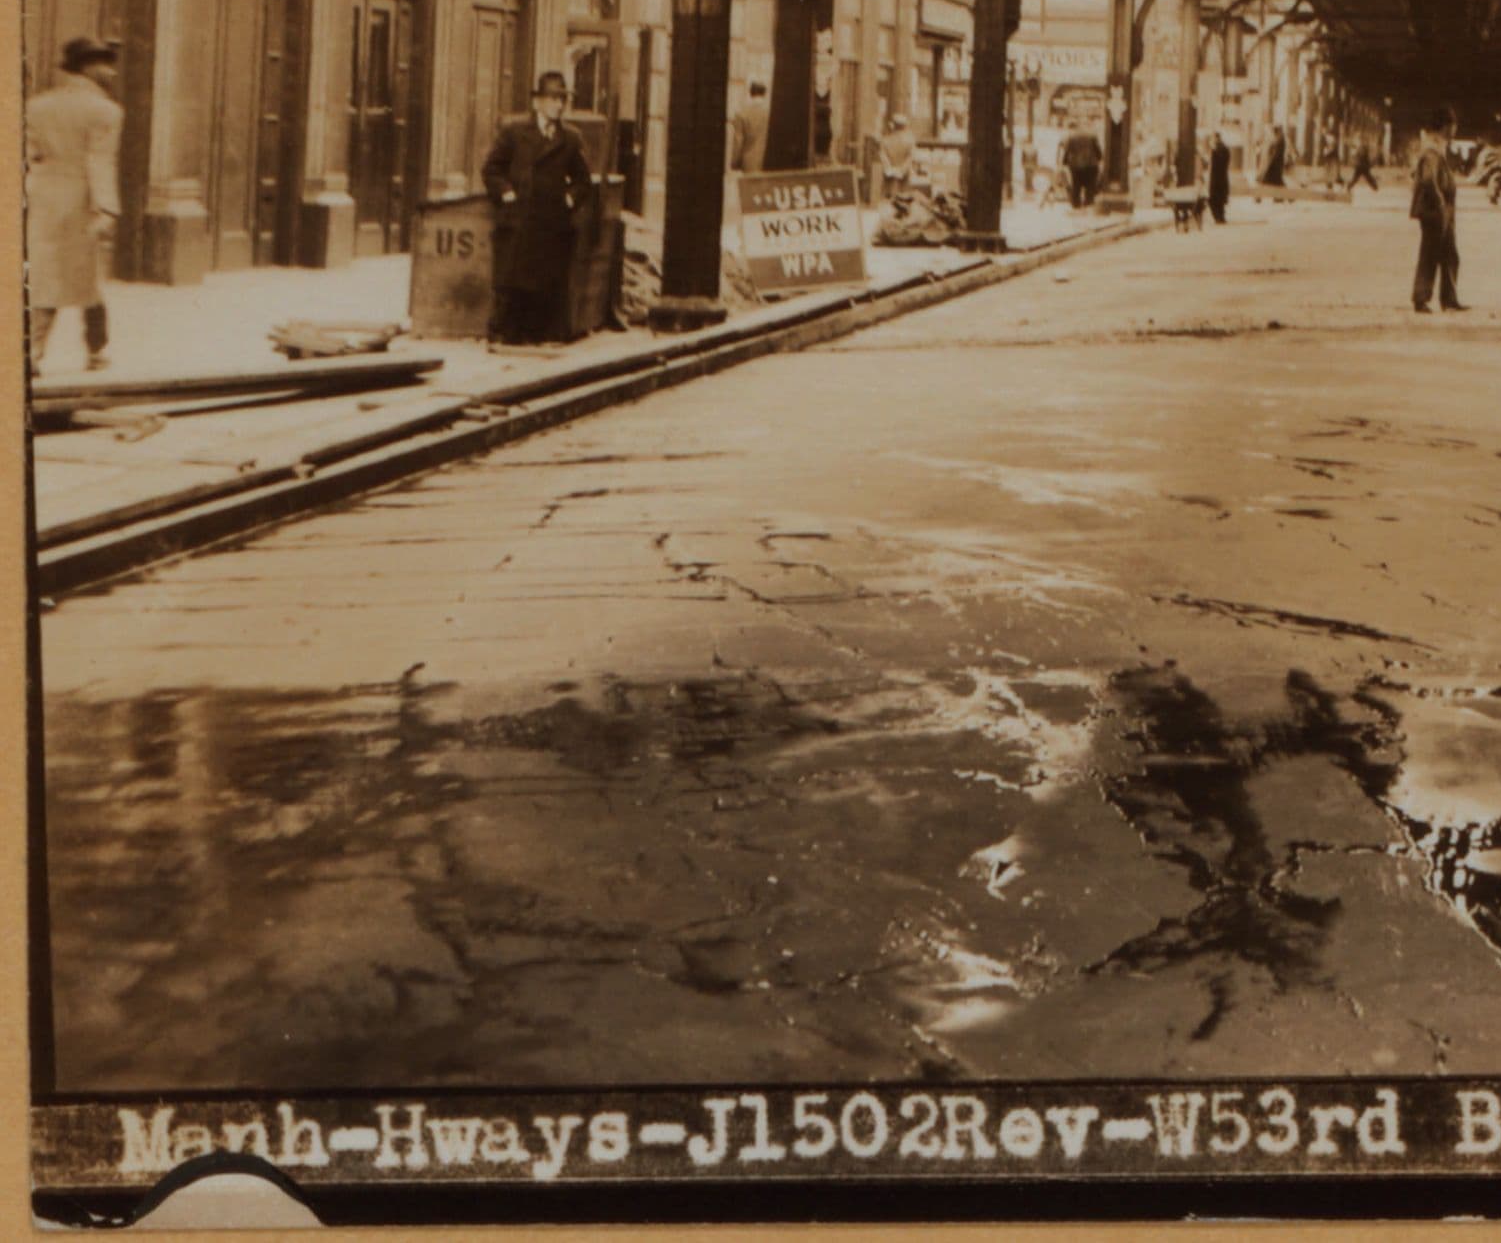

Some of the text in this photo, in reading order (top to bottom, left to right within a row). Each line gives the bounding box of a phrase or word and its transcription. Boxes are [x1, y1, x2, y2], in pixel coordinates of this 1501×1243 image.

[772, 183, 825, 211] USA
[760, 213, 843, 239] WORK
[436, 228, 475, 261] US
[781, 251, 835, 279] WPA
